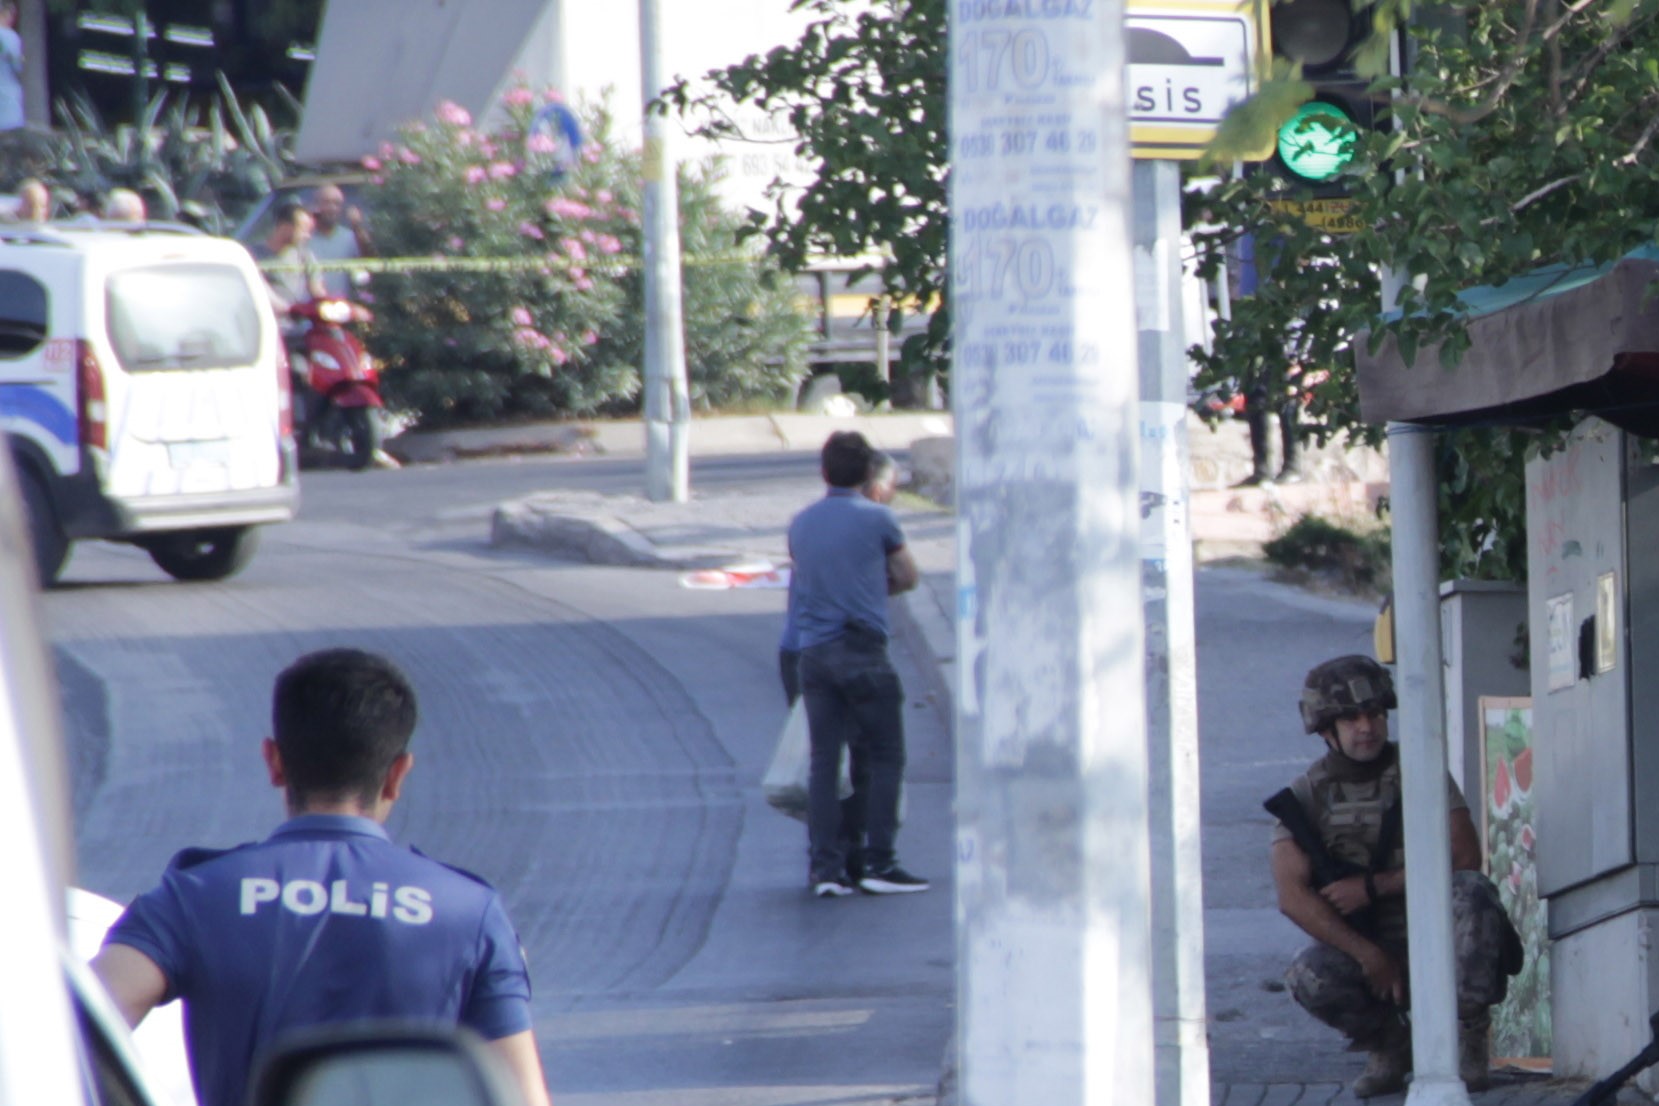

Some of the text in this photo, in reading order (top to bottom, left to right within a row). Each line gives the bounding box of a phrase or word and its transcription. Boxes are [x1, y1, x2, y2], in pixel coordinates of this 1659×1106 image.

[958, 26, 1050, 94] 170
[1133, 78, 1202, 113] sis
[960, 234, 1054, 300] 170
